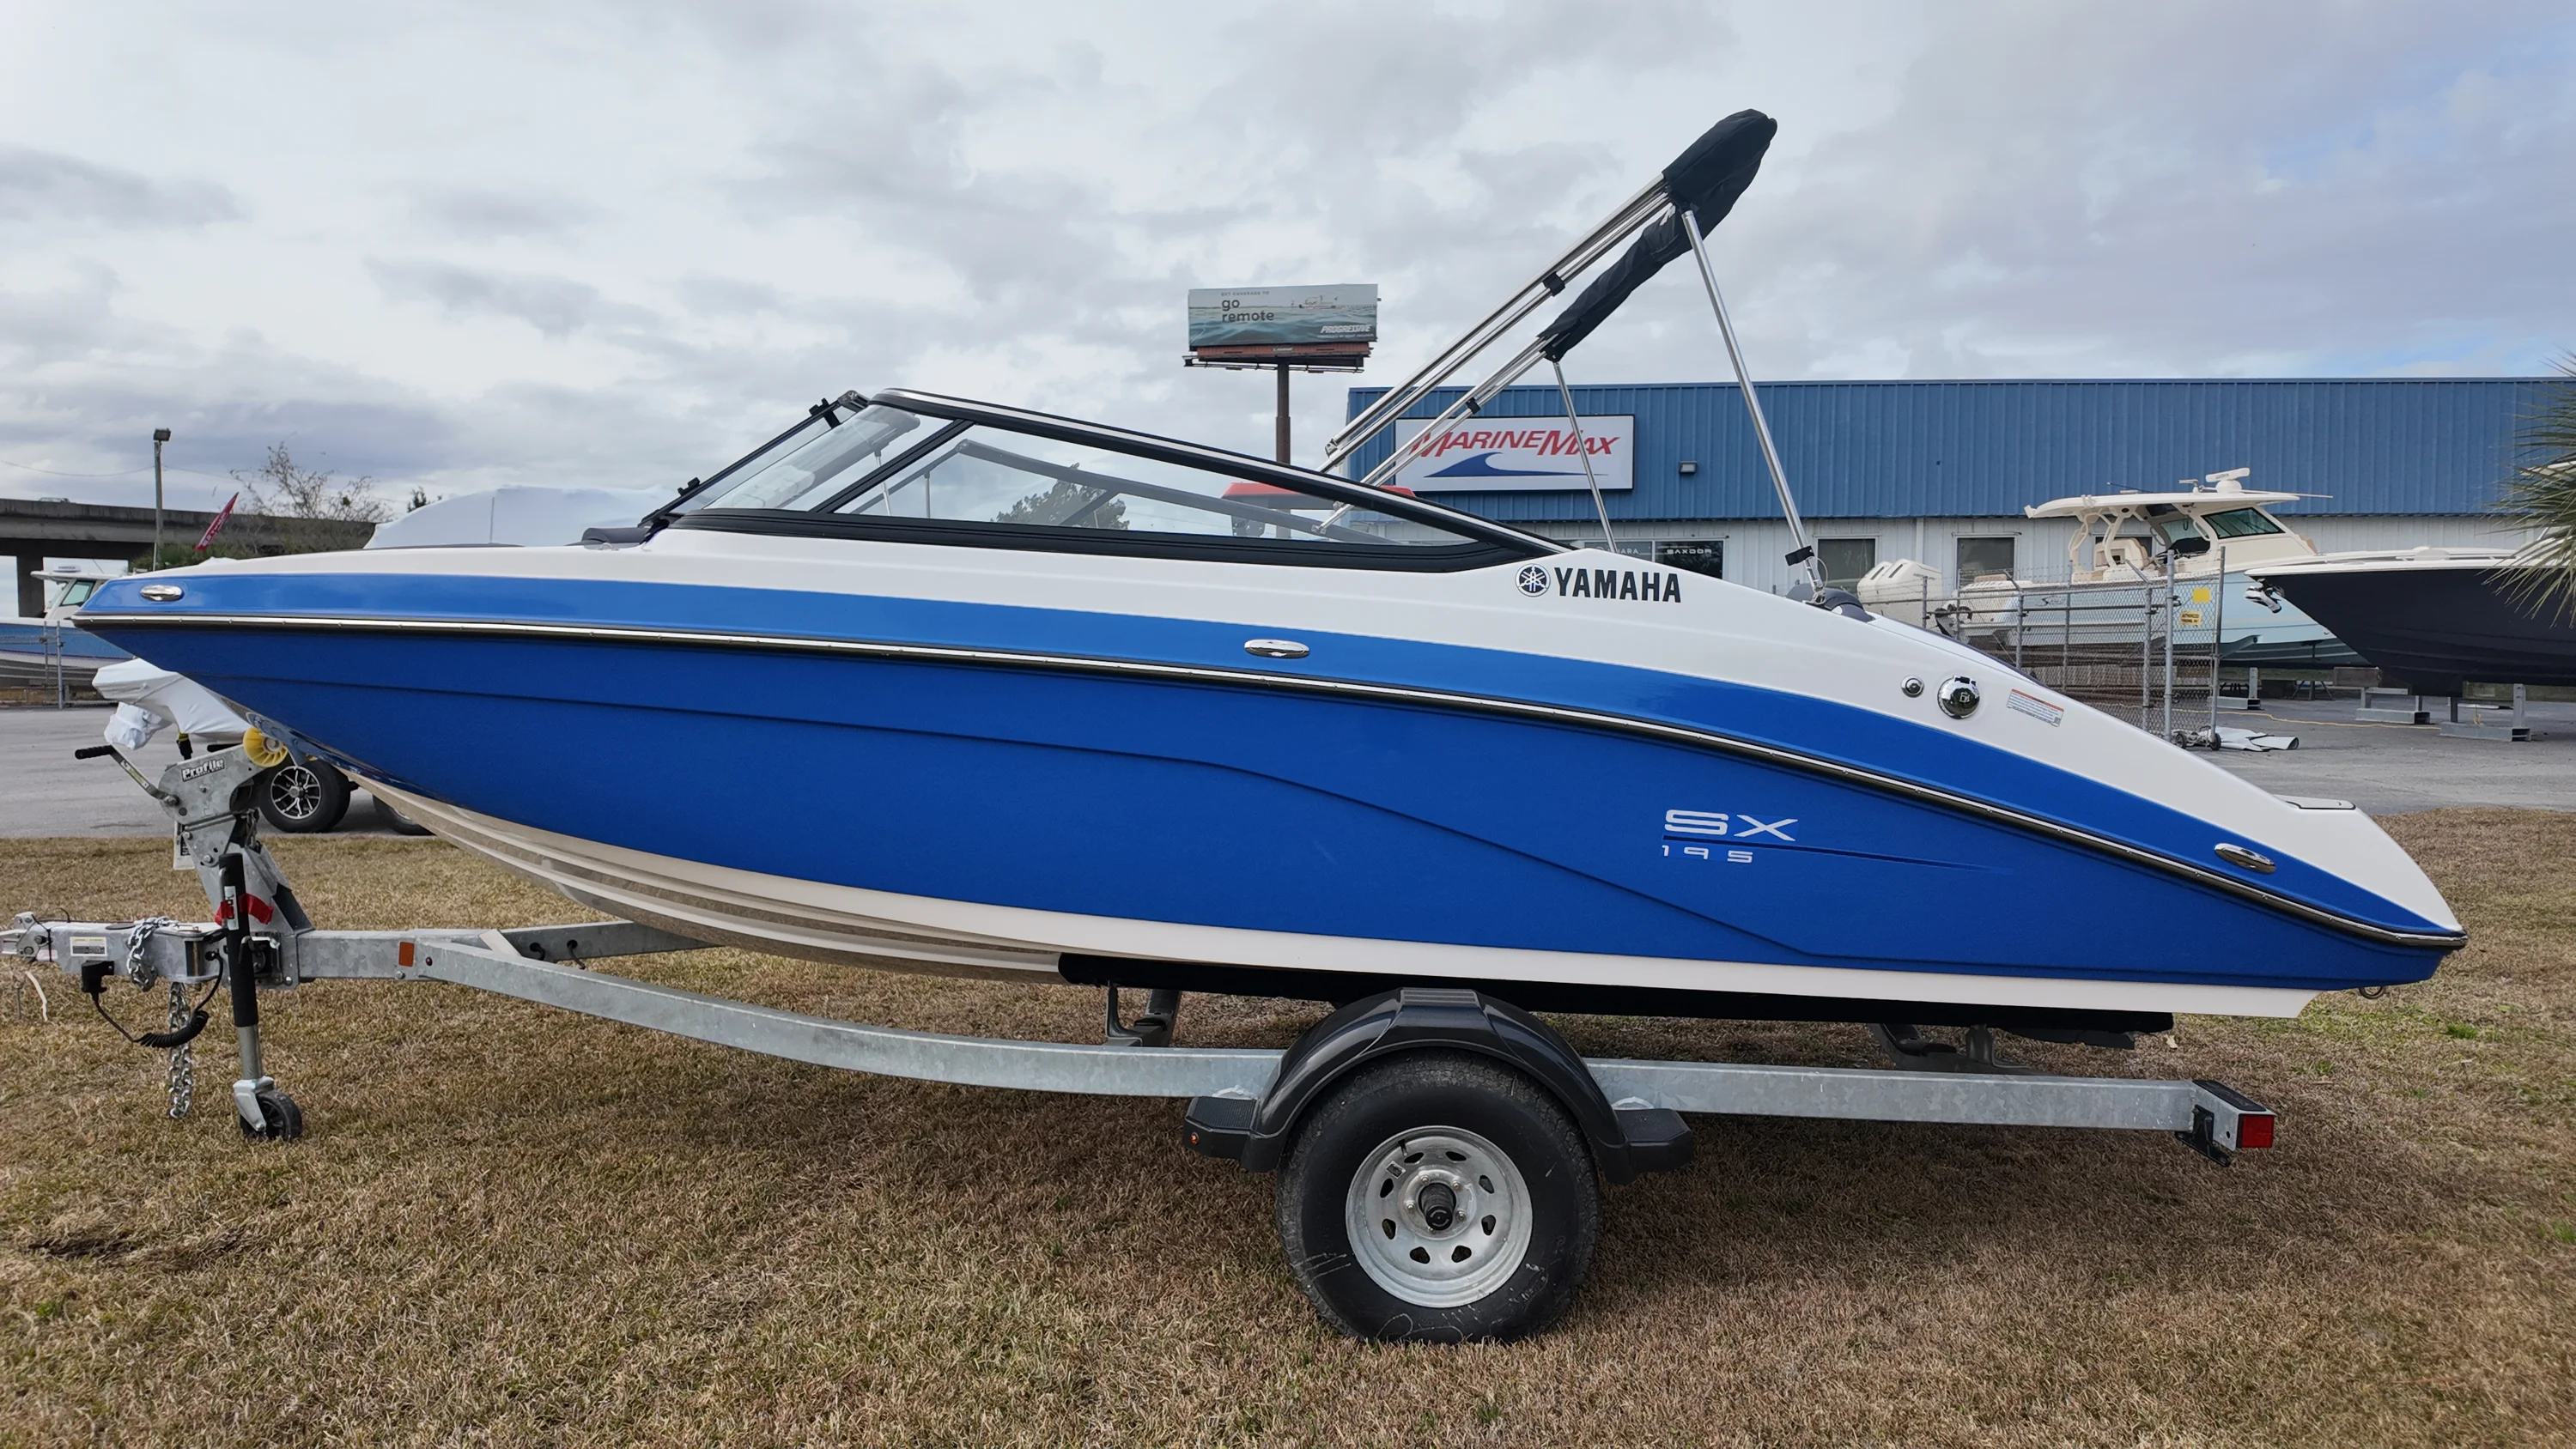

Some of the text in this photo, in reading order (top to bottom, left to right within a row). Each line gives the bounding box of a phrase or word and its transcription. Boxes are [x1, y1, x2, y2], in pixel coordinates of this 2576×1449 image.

[1222, 299, 1240, 312] go
[1222, 311, 1274, 322] remote
[1553, 567, 1681, 603] YAMAHA
[182, 759, 224, 779] Profile
[1664, 809, 1799, 841] SX
